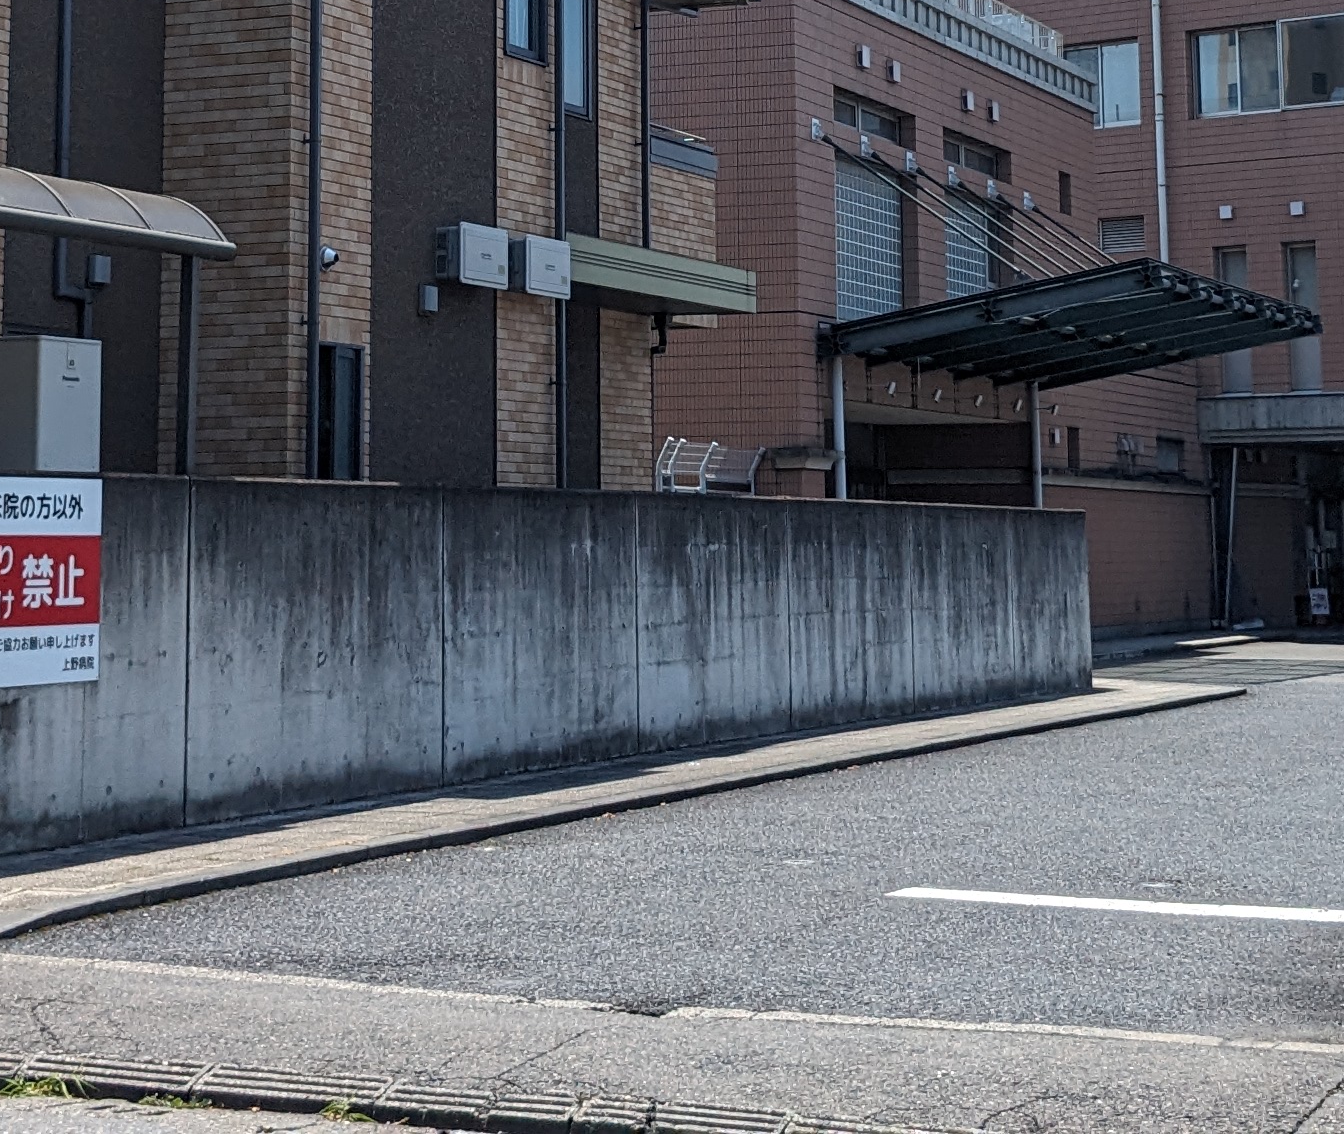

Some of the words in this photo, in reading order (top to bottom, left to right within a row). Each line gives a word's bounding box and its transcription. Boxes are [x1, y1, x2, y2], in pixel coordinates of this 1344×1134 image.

[22, 553, 85, 609] 禁止
[62, 656, 95, 672] 上野病院
